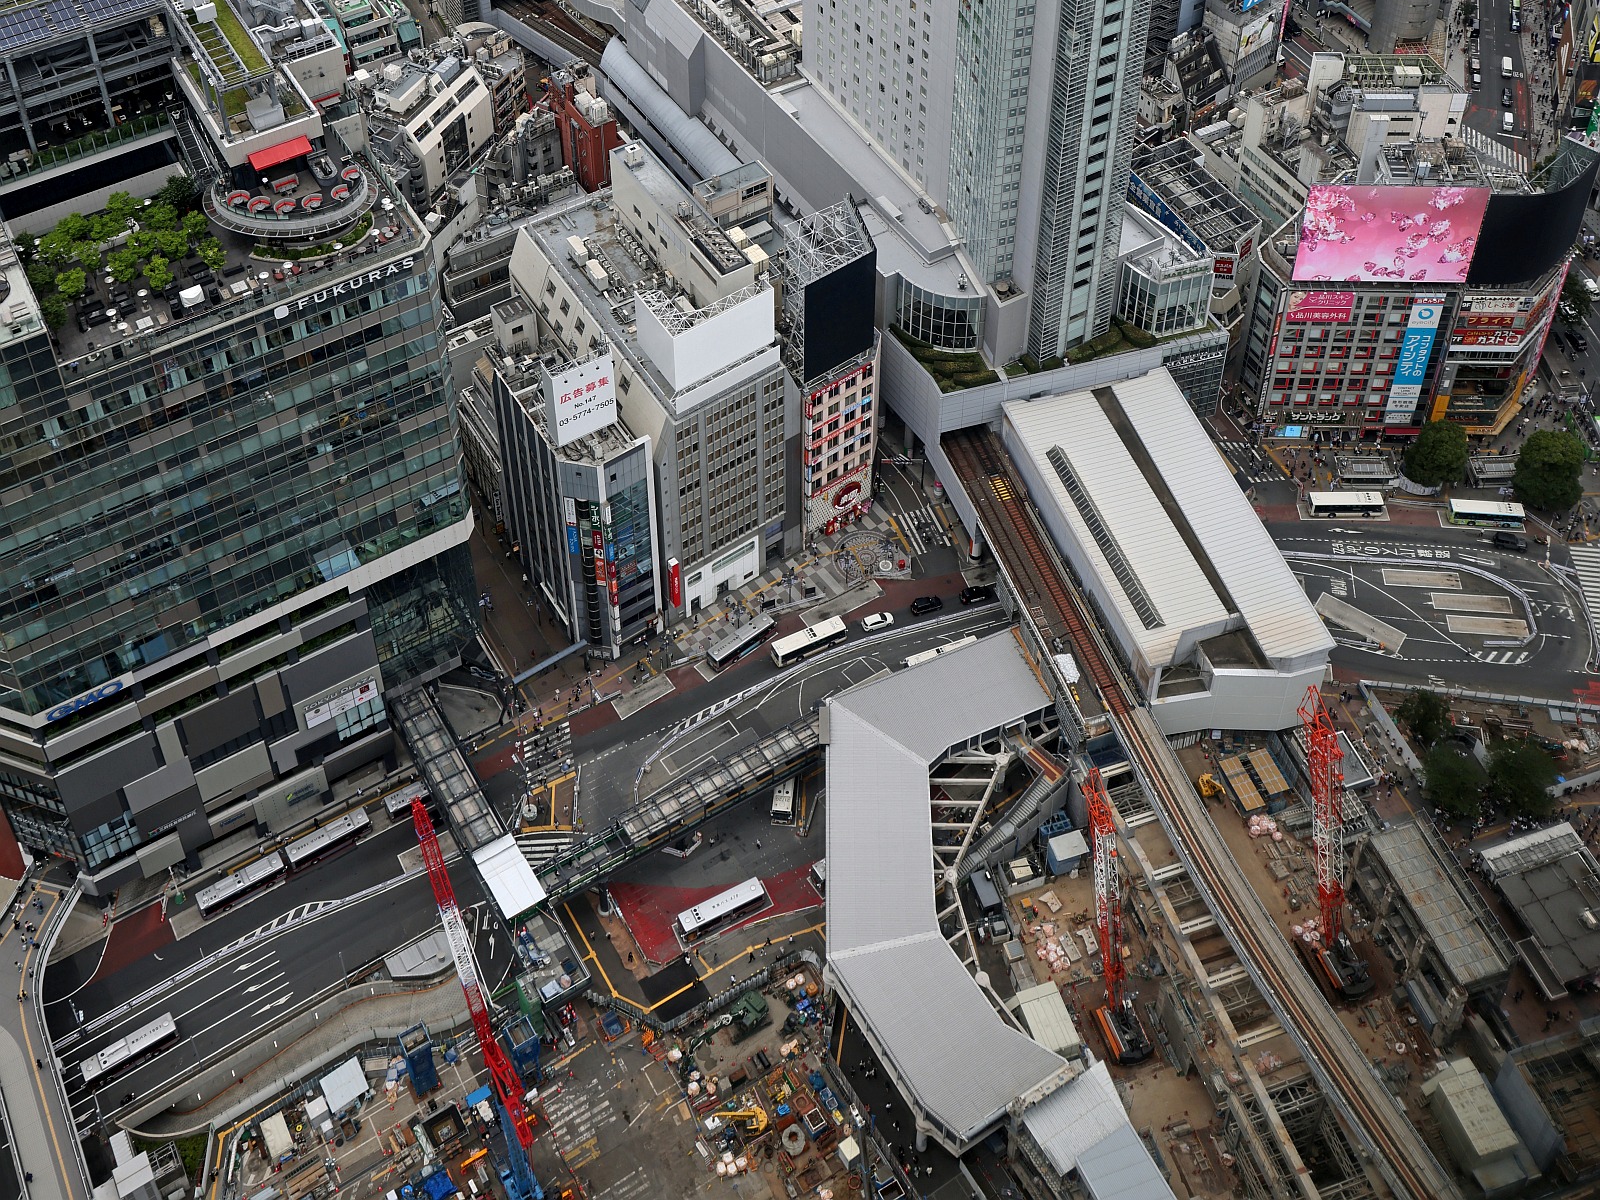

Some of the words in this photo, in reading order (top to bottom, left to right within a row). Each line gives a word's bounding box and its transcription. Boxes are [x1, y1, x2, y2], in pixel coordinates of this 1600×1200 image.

[297, 256, 414, 311] FUKURAS
[1295, 311, 1347, 320] 品川美容外科
[1476, 335, 1504, 345] ガスト
[1400, 335, 1421, 377] アイシティ
[1412, 335, 1431, 377] コンタクトの
[560, 376, 610, 405] 広告募集
[574, 395, 597, 409] No.147
[559, 397, 615, 427] 03-5774-7505
[1291, 412, 1341, 421] サンドラッグ
[47, 681, 124, 722] GMO
[303, 692, 338, 711] TOKYU
